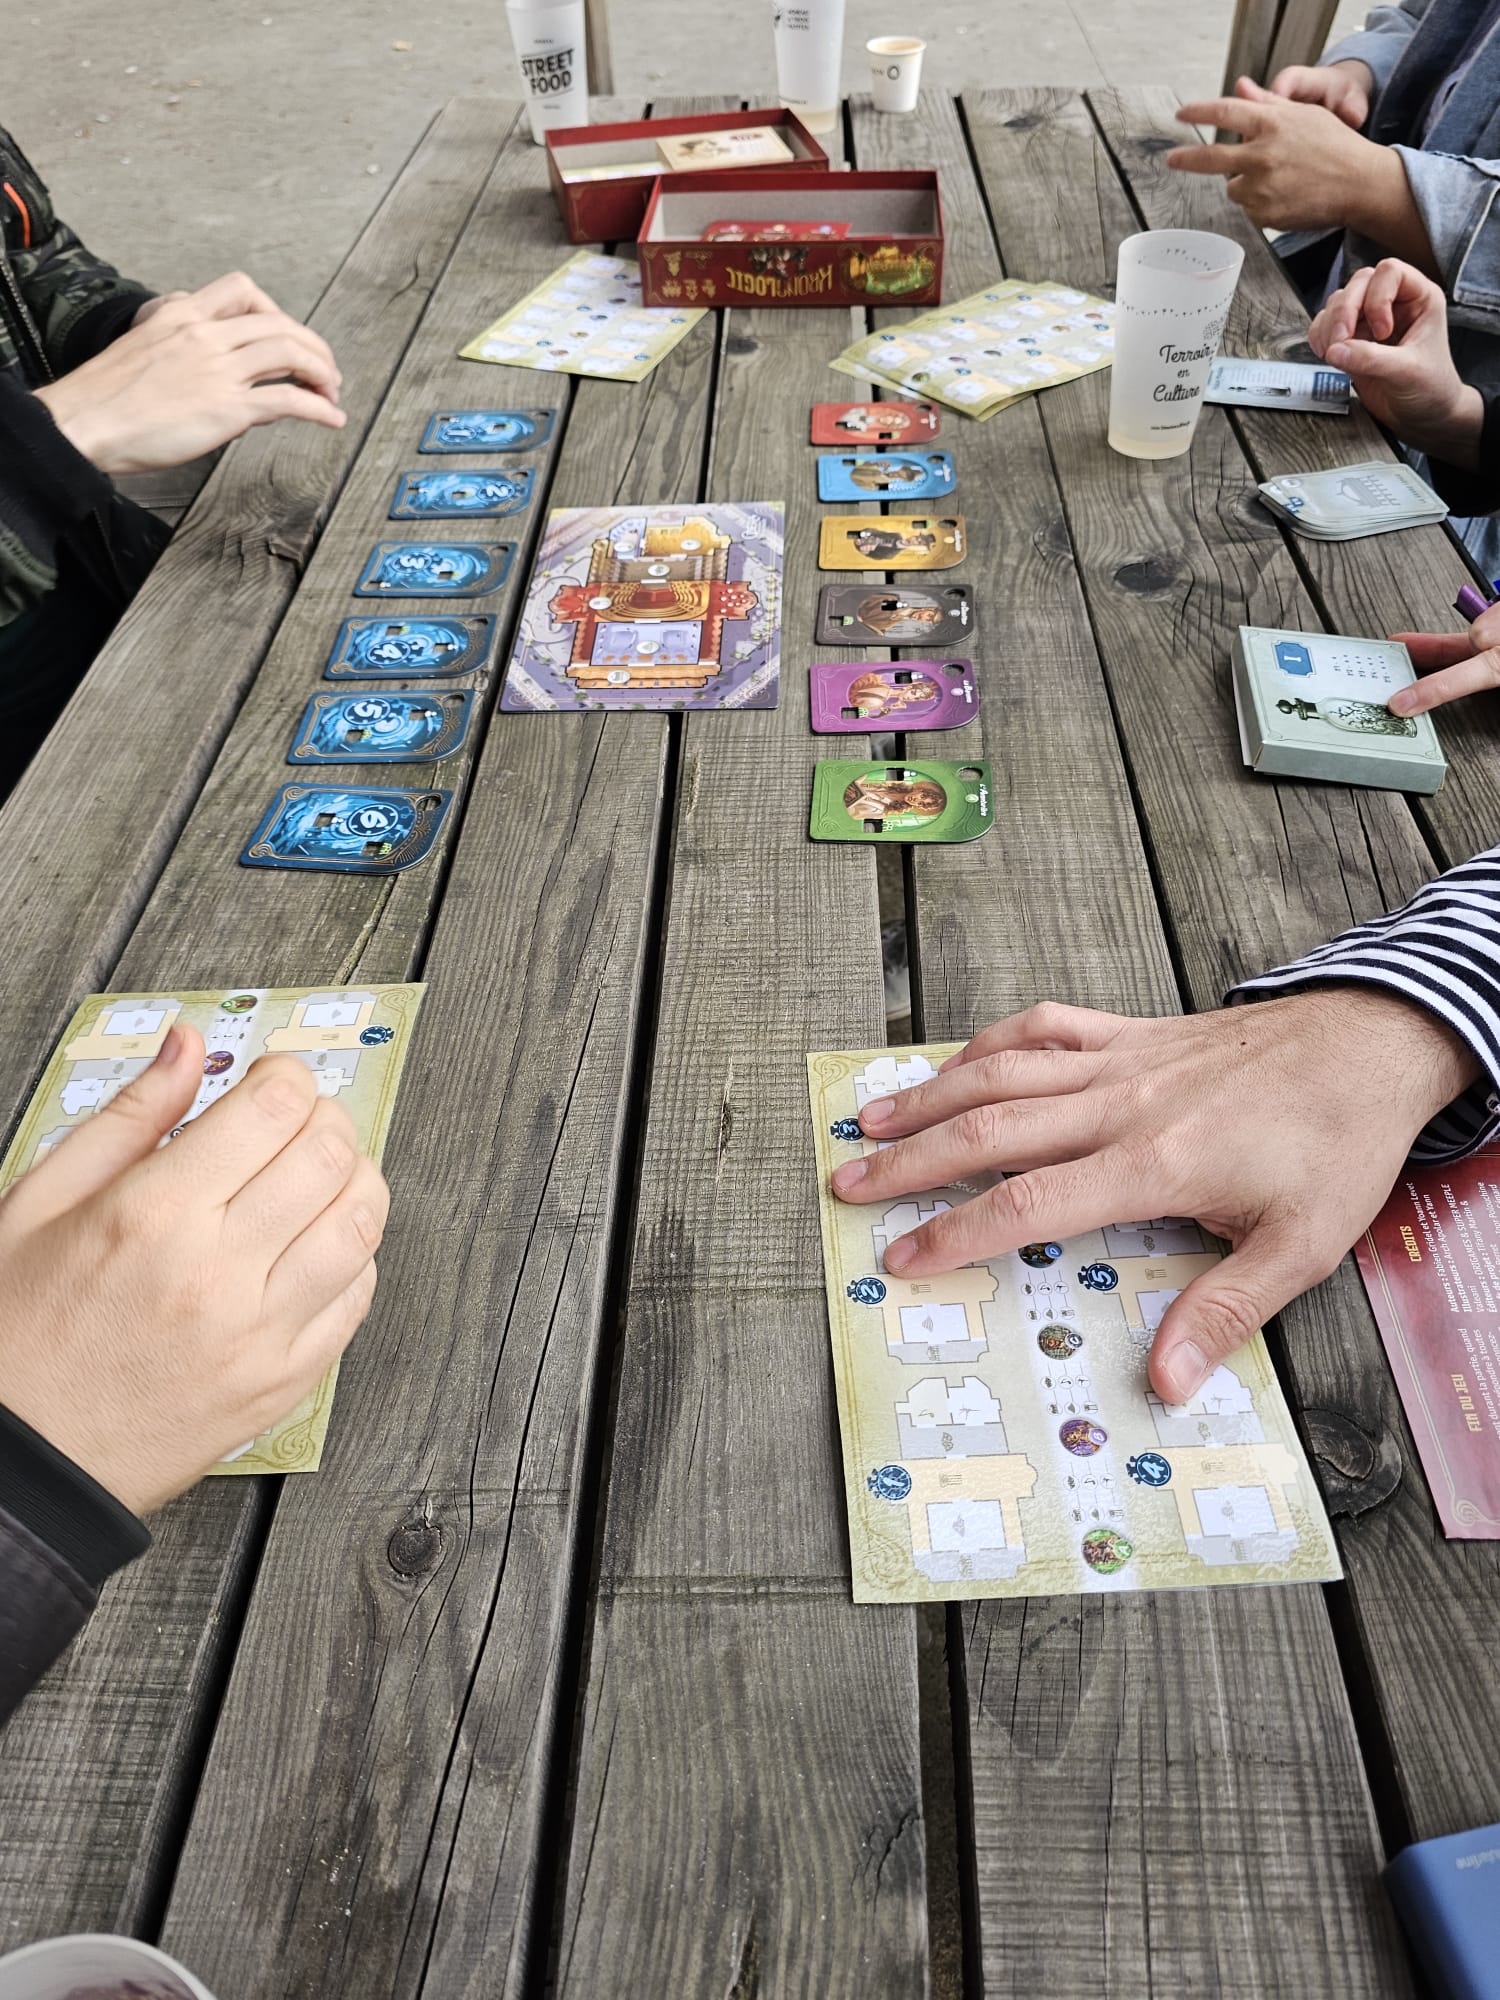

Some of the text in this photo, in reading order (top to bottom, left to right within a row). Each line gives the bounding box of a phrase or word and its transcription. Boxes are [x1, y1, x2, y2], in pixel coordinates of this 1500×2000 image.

[522, 48, 574, 76] STREET
[530, 70, 572, 95] FOOD
[1177, 369, 1190, 378] en
[1153, 384, 1200, 402] Culture
[486, 485, 509, 496] 2
[400, 555, 425, 568] 3
[374, 643, 403, 659] 4
[354, 702, 382, 719] 5
[360, 811, 388, 829] 6
[843, 1124, 860, 1136] 3
[1406, 1182, 1418, 1200] Levet
[1441, 1184, 1457, 1209] MEEPLE
[1478, 1181, 1497, 1219] Polouchine
[1414, 1201, 1426, 1222] Yoann
[1423, 1194, 1434, 1214] Yann
[1429, 1210, 1437, 1220] et
[1452, 1209, 1465, 1231] SUPER
[1464, 1207, 1477, 1229] Martin
[1421, 1222, 1429, 1230] et
[1433, 1219, 1446, 1242] Apolar
[1400, 1225, 1422, 1262] CRÉDITS
[1422, 1231, 1437, 1252] Gridel
[1440, 1243, 1453, 1260] Arch
[1433, 1253, 1447, 1277] Fabien
[1462, 1239, 1483, 1276] ORIGAMES
[1092, 1270, 1111, 1286] 5
[1483, 1257, 1500, 1280] projet
[861, 1284, 879, 1299] 2
[1443, 1282, 1460, 1313] Auteurs
[1449, 1264, 1472, 1313] Illustrateurs
[1481, 1280, 1498, 1313] Éditeurs
[1457, 1328, 1474, 1353] quand
[1474, 1328, 1488, 1354] toutes
[1469, 1354, 1487, 1384] partie,
[1479, 1382, 1488, 1391] la
[1451, 1374, 1482, 1432] FIN DU JEU
[1482, 1392, 1498, 1420] durant
[1142, 1461, 1164, 1478] 4
[883, 1477, 905, 1487] 1
